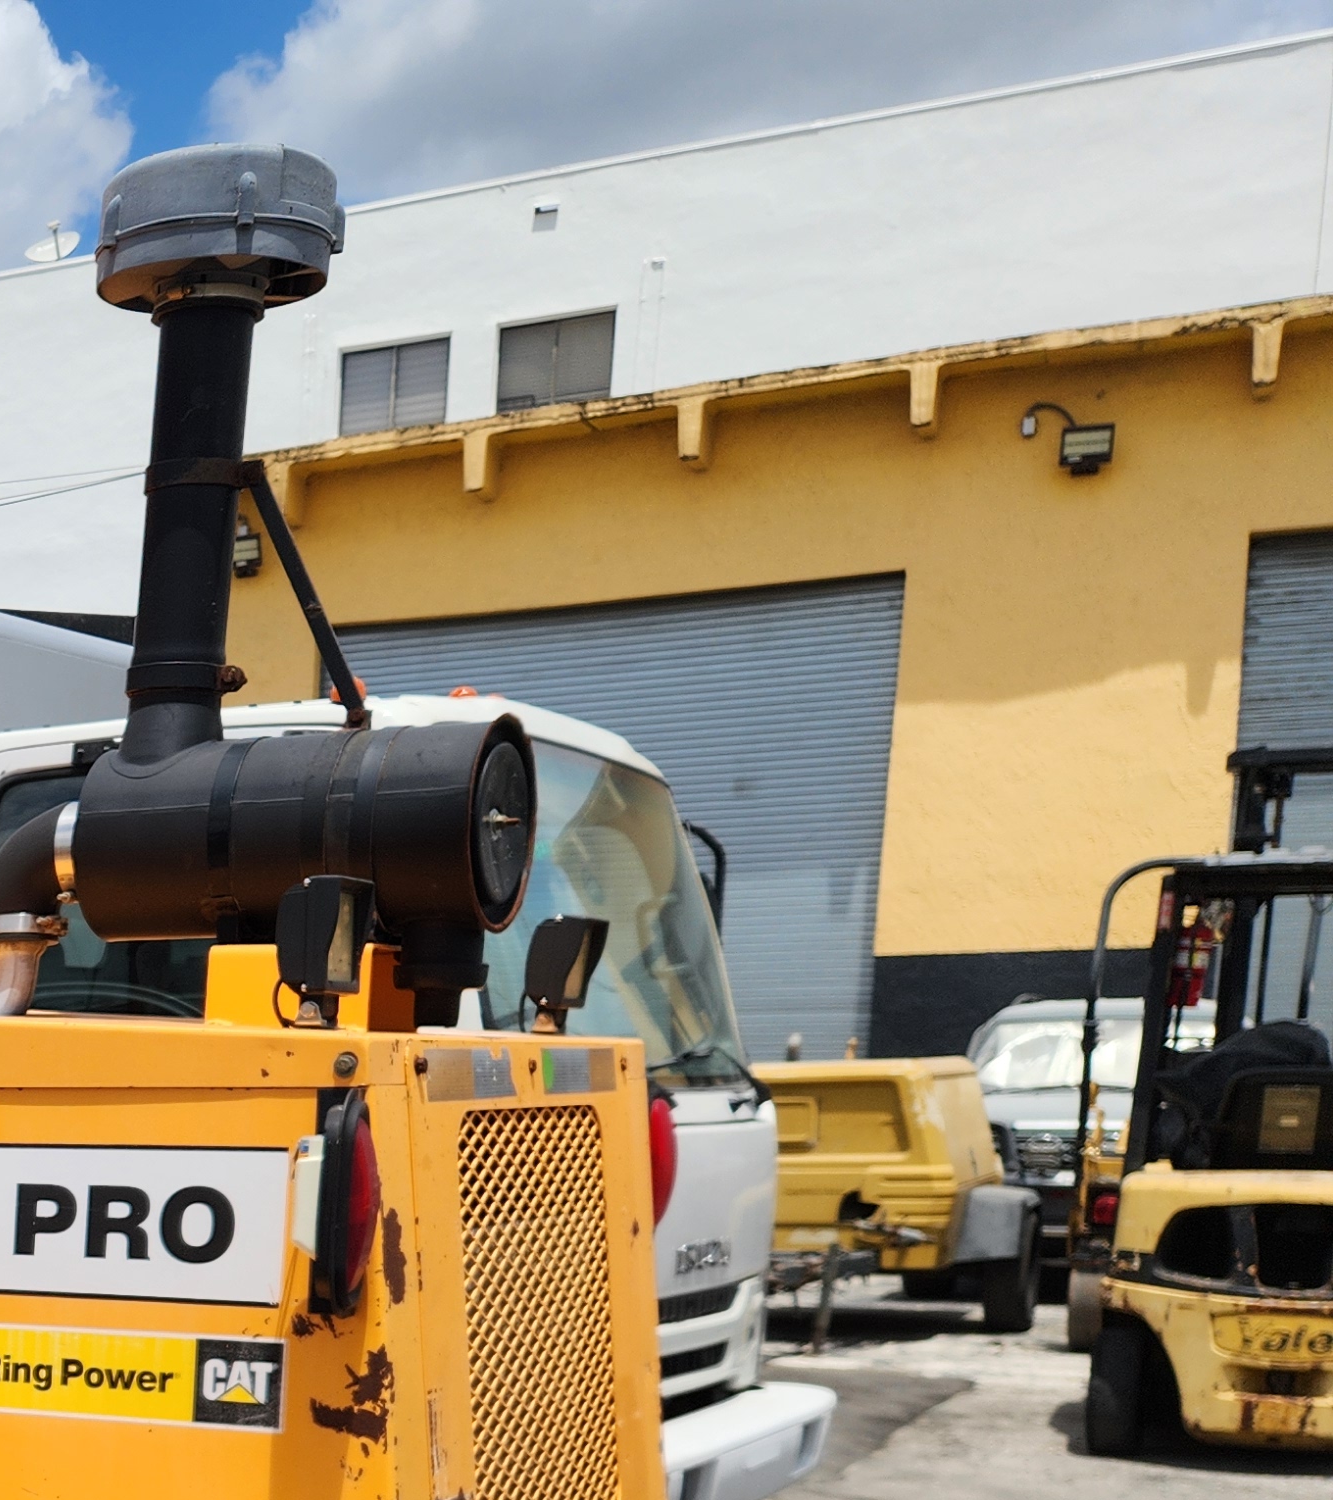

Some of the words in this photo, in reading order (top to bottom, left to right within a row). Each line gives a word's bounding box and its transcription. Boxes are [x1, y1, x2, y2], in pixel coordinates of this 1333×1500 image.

[12, 1183, 236, 1264] PRO
[61, 1358, 174, 1393] Power
[202, 1358, 276, 1405] CAT
